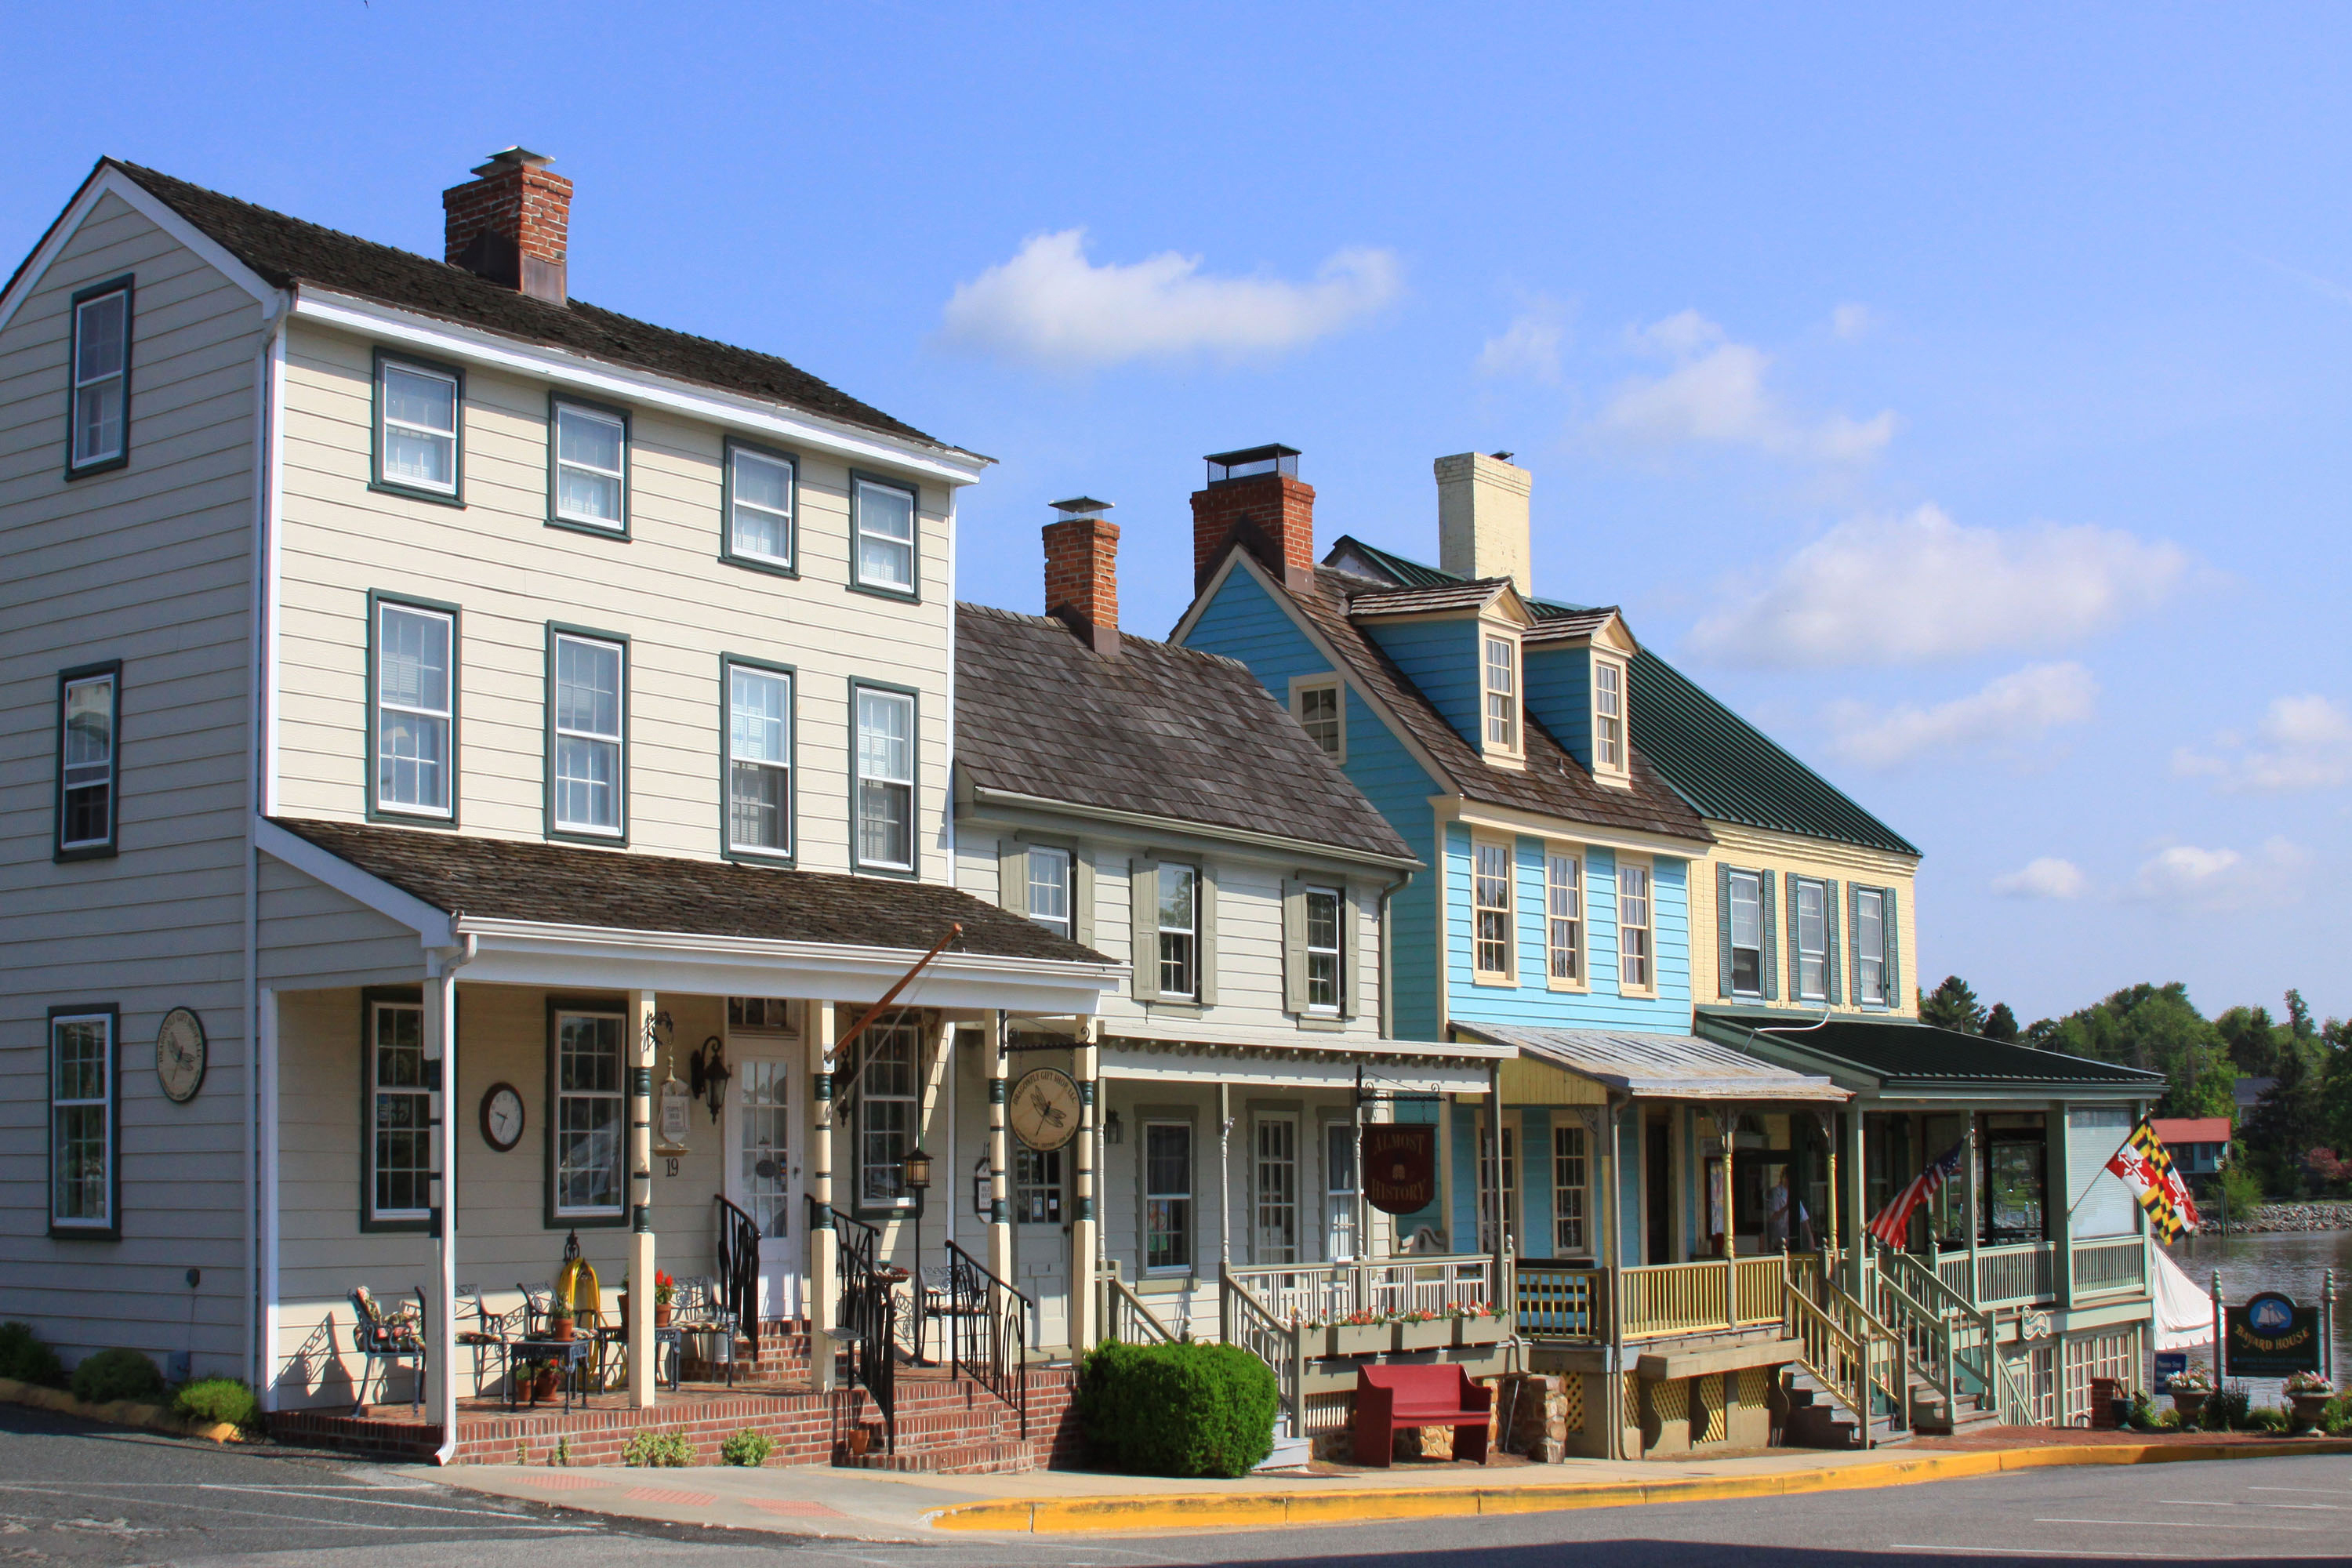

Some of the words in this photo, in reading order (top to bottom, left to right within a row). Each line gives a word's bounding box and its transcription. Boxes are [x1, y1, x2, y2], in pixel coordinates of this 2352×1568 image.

[1012, 1074, 1040, 1105] DRAGONFLY
[1040, 1071, 1054, 1081] GIFT
[1067, 1087, 1078, 1104] LLC
[1373, 1133, 1425, 1155] ALMOST
[665, 1157, 679, 1177] 19
[1371, 1178, 1426, 1200] HISTORY
[2234, 1323, 2274, 1352] BAYARD
[2274, 1326, 2310, 1351] HOUSE
